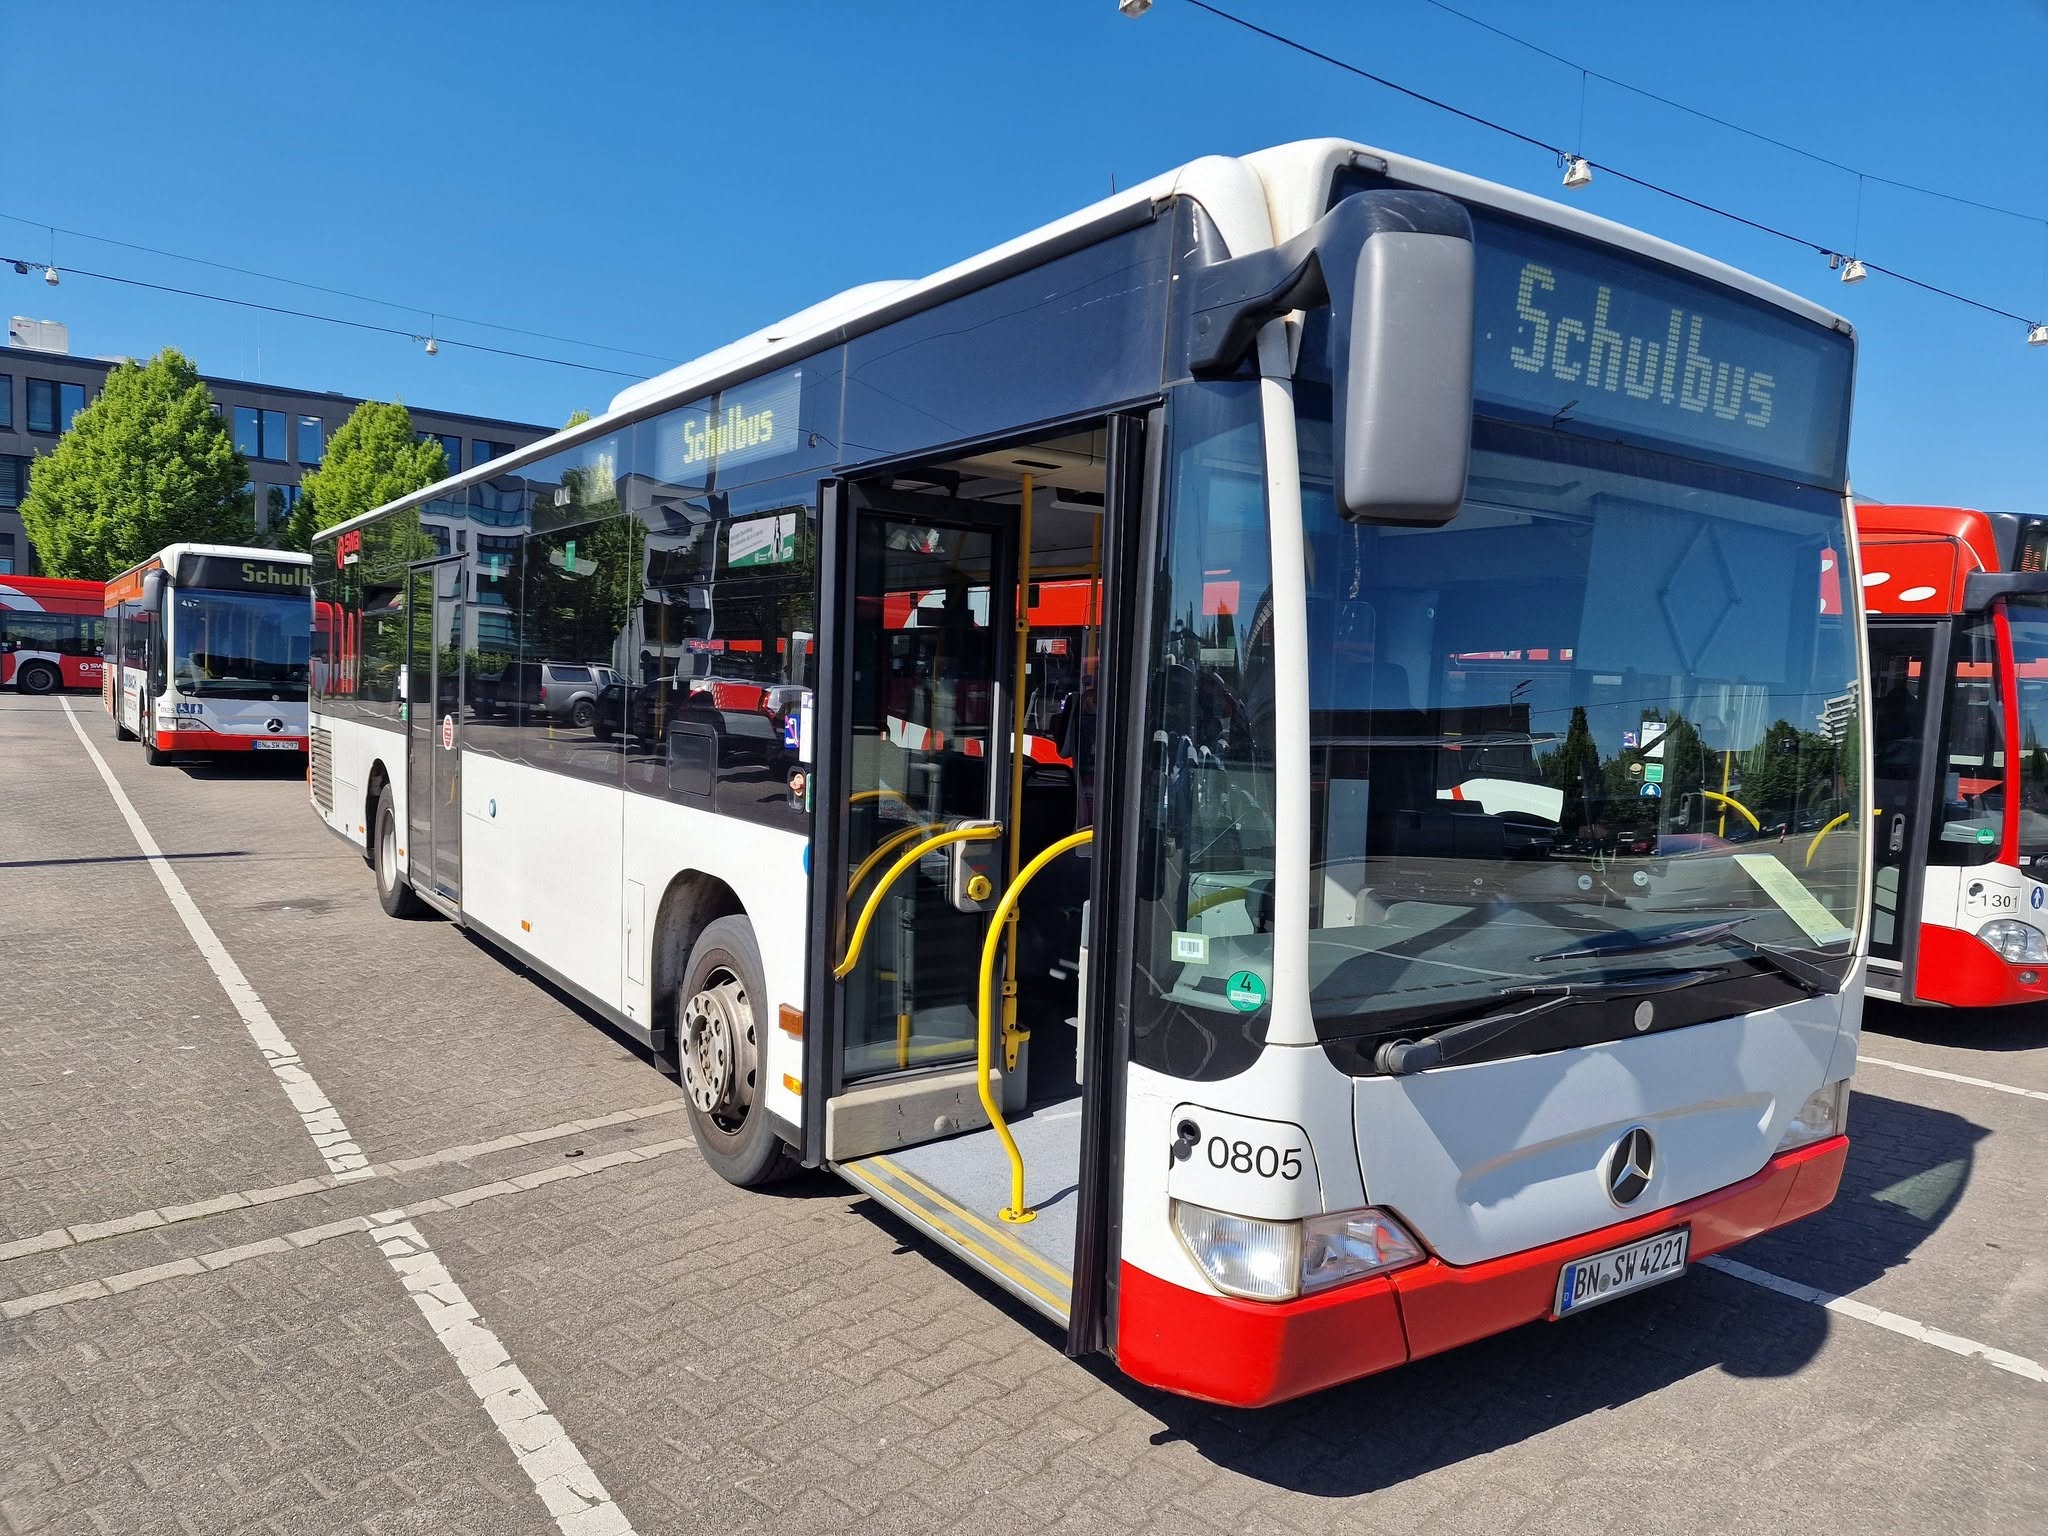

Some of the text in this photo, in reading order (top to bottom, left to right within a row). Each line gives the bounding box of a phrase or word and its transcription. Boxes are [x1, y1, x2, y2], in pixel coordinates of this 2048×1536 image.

[1510, 263, 1776, 428] Schulbus
[682, 402, 774, 465] Schulbus
[1981, 893, 2018, 909] 1301
[1240, 973, 1252, 992] 4
[1207, 1136, 1303, 1181] 0805
[1573, 1263, 1600, 1300] BN
[1612, 1250, 1638, 1286] SW
[1640, 1236, 1683, 1276] 4221
